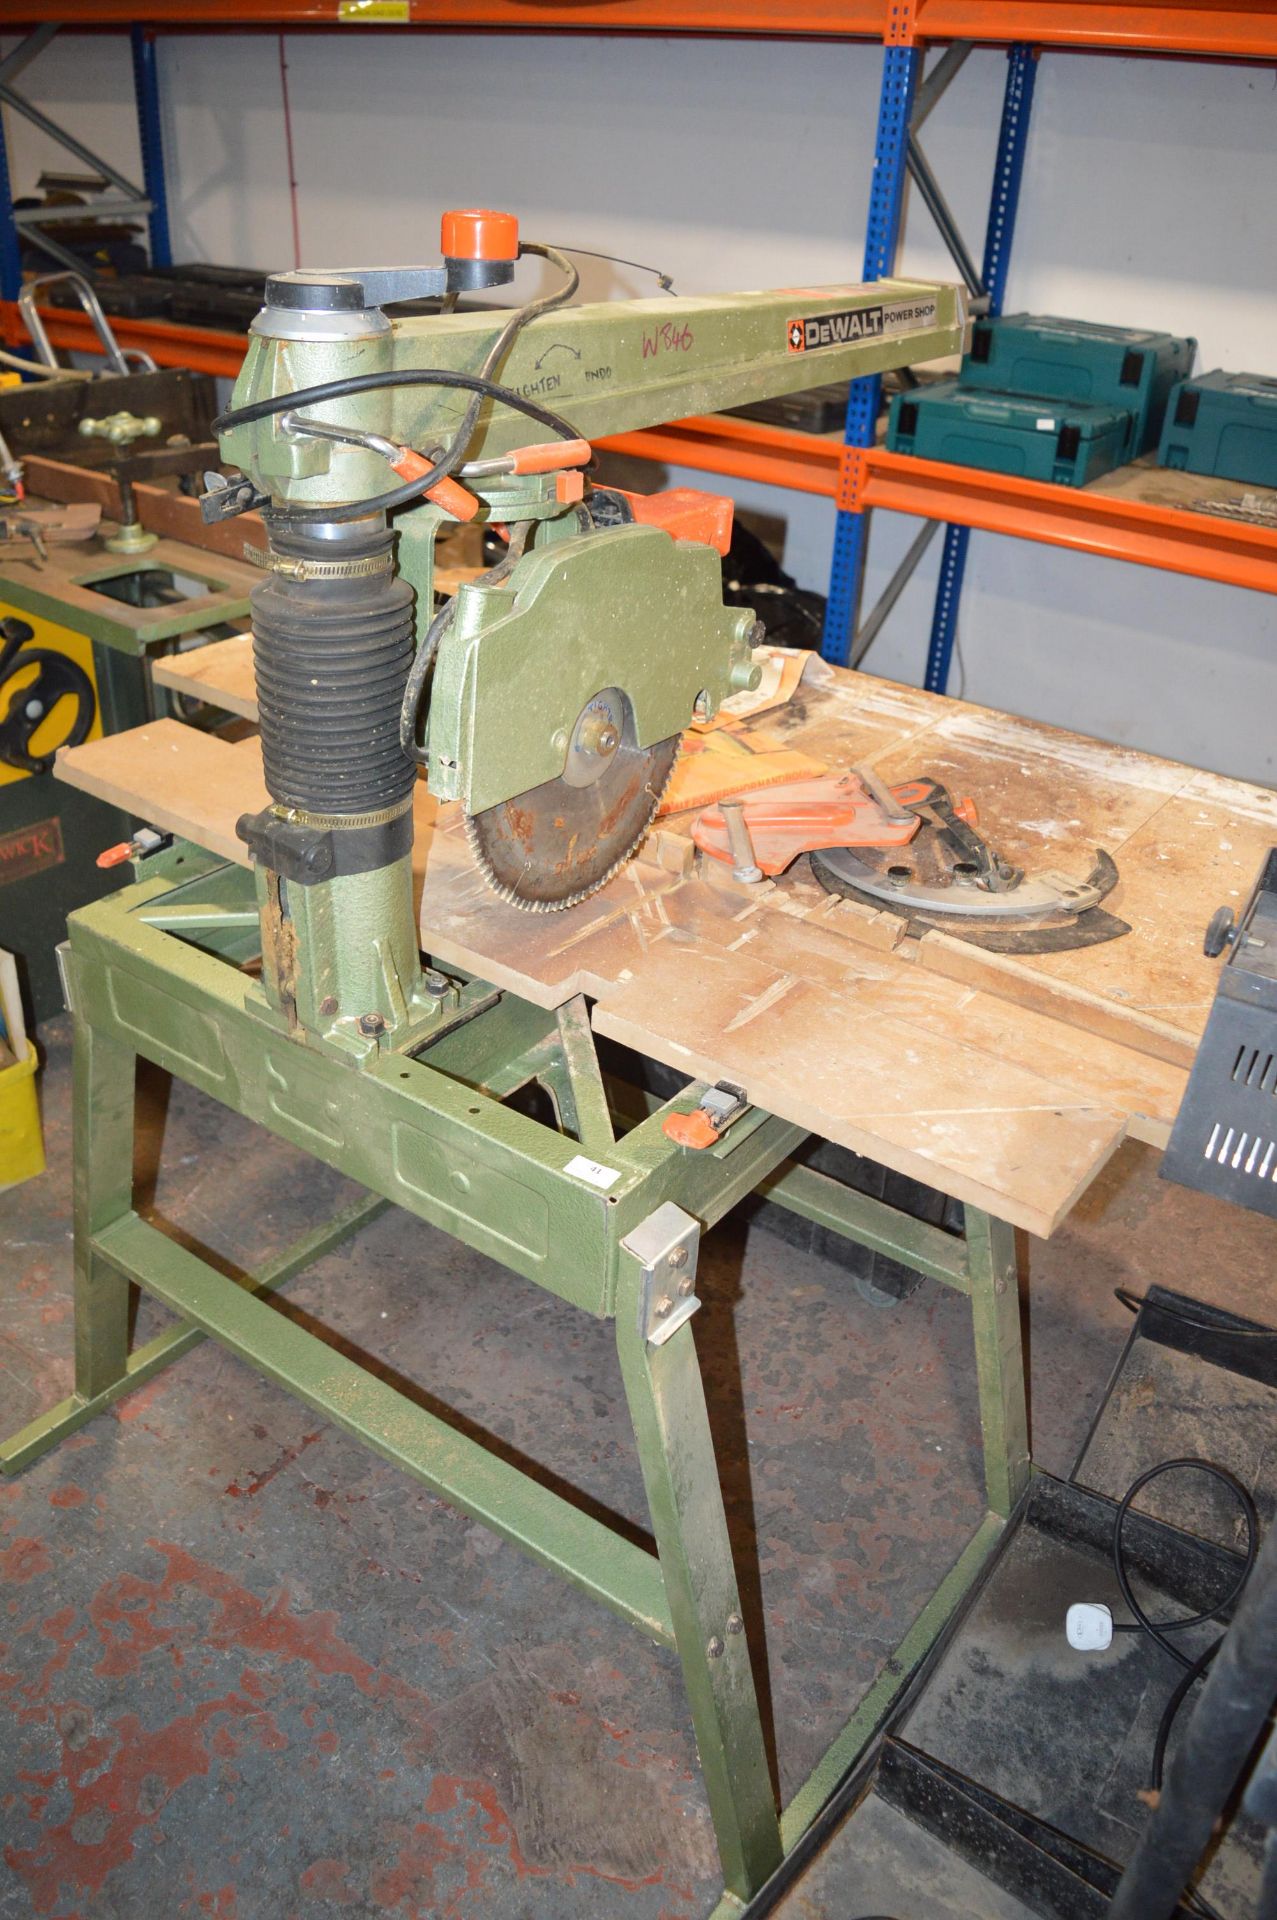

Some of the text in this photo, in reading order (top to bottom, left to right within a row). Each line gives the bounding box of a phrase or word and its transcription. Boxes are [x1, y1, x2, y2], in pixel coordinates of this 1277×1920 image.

[884, 308, 914, 324] POWER
[914, 304, 936, 319] SHOP
[507, 374, 561, 397] IGHTEN
